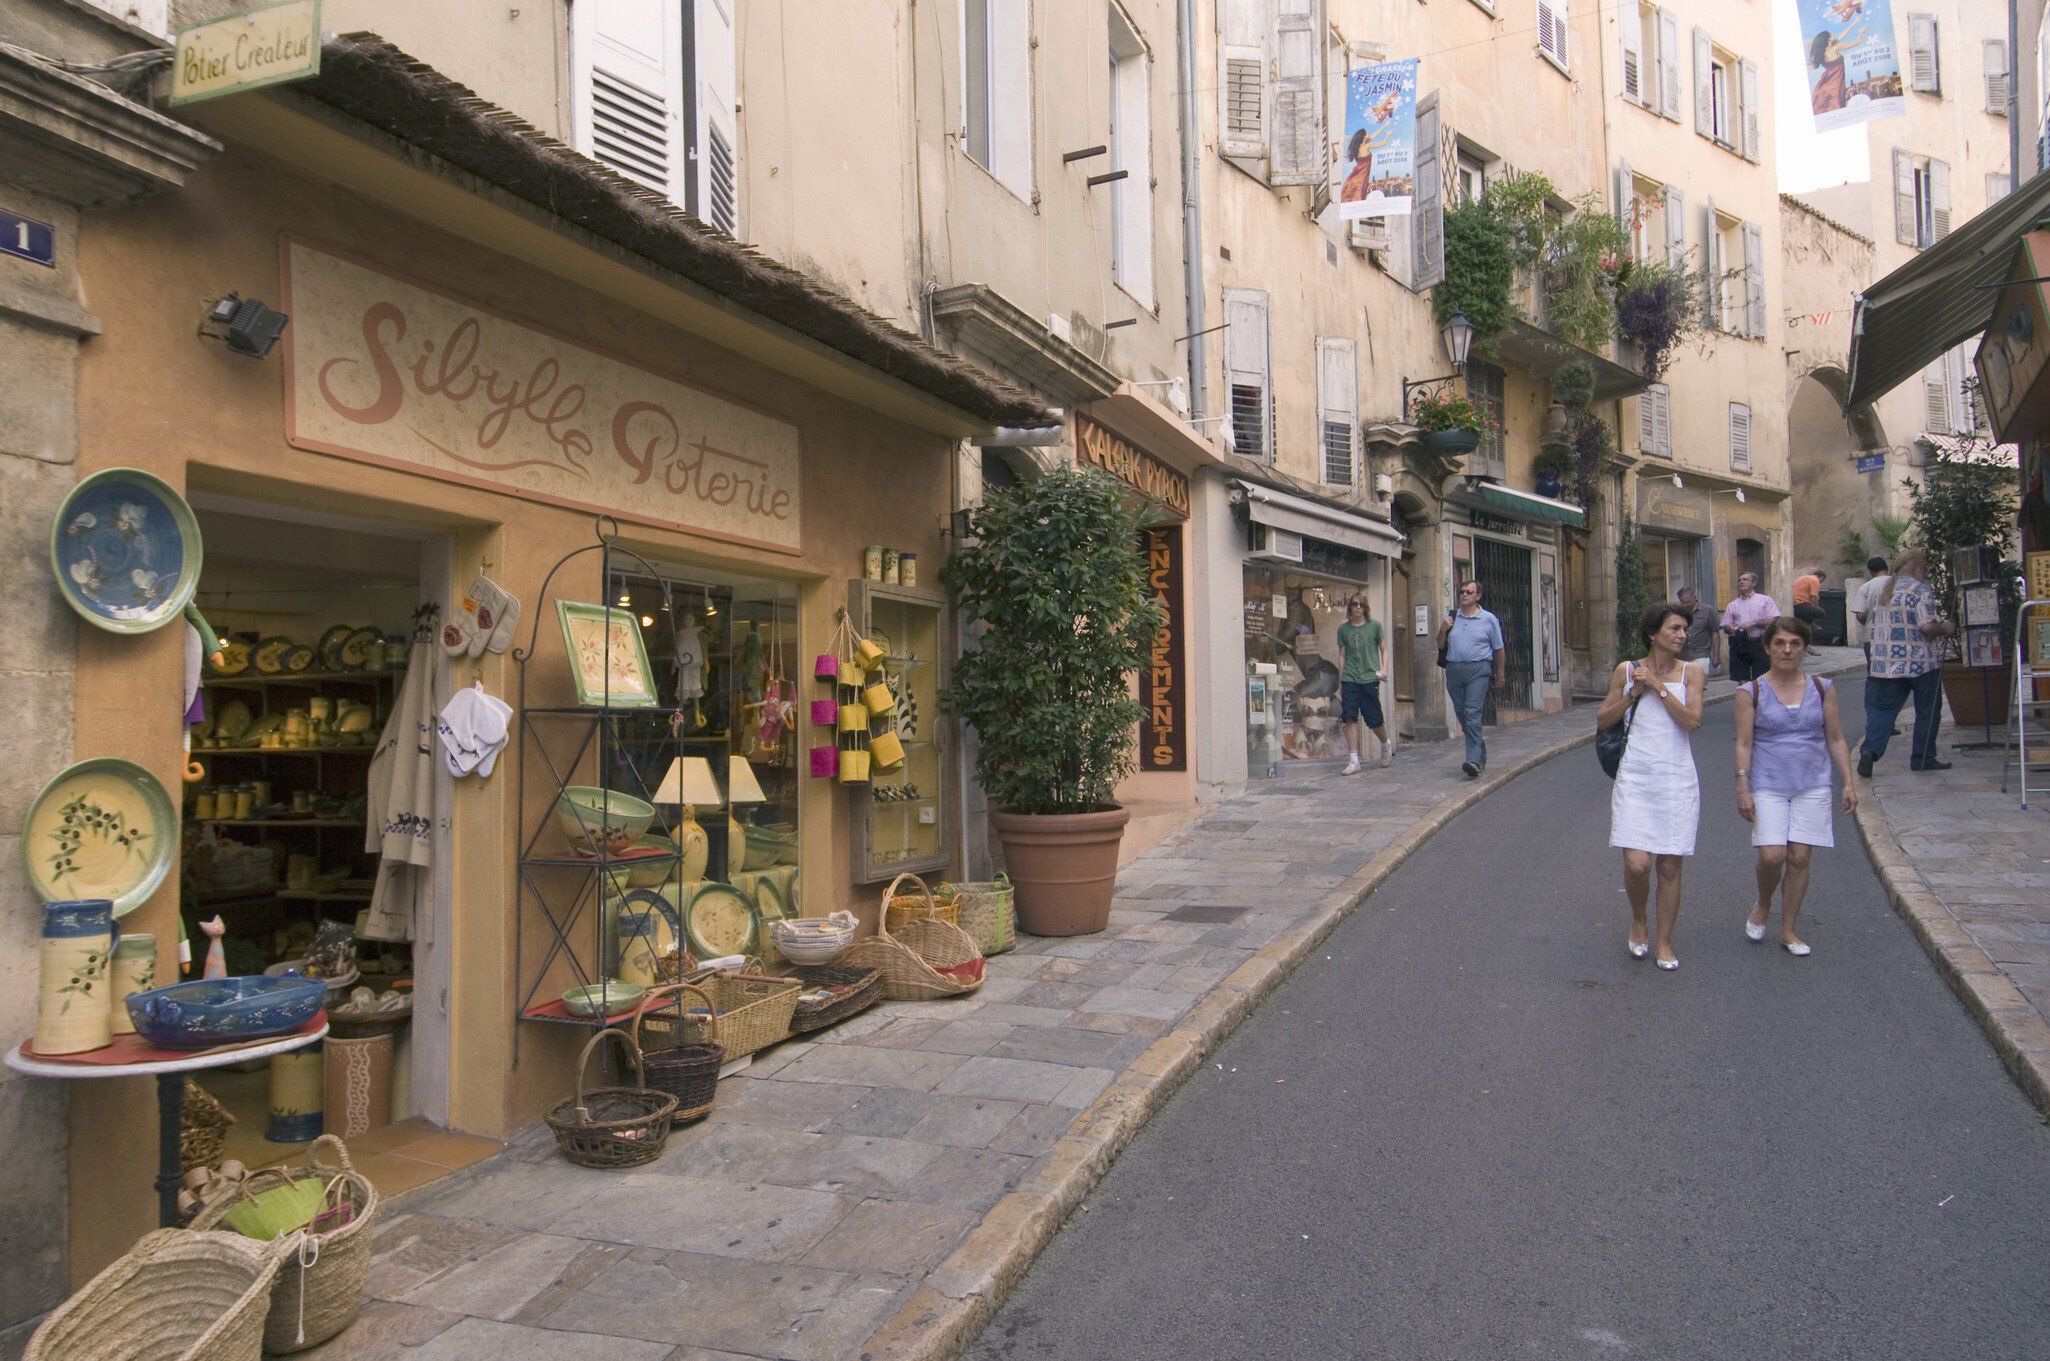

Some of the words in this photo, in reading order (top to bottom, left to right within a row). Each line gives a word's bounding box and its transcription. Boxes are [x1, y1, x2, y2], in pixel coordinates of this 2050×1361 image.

[183, 46, 230, 86] Potier
[235, 28, 310, 71] Créateur
[1387, 72, 1402, 82] DU
[1364, 82, 1403, 97] JASMIN
[15, 221, 31, 251] 1
[317, 301, 593, 480] Sibylle
[611, 400, 791, 520] Poterie
[1082, 421, 1143, 490] GALERIE
[1143, 457, 1189, 512] PYROS
[1150, 530, 1174, 766] ENCADREMENTS
